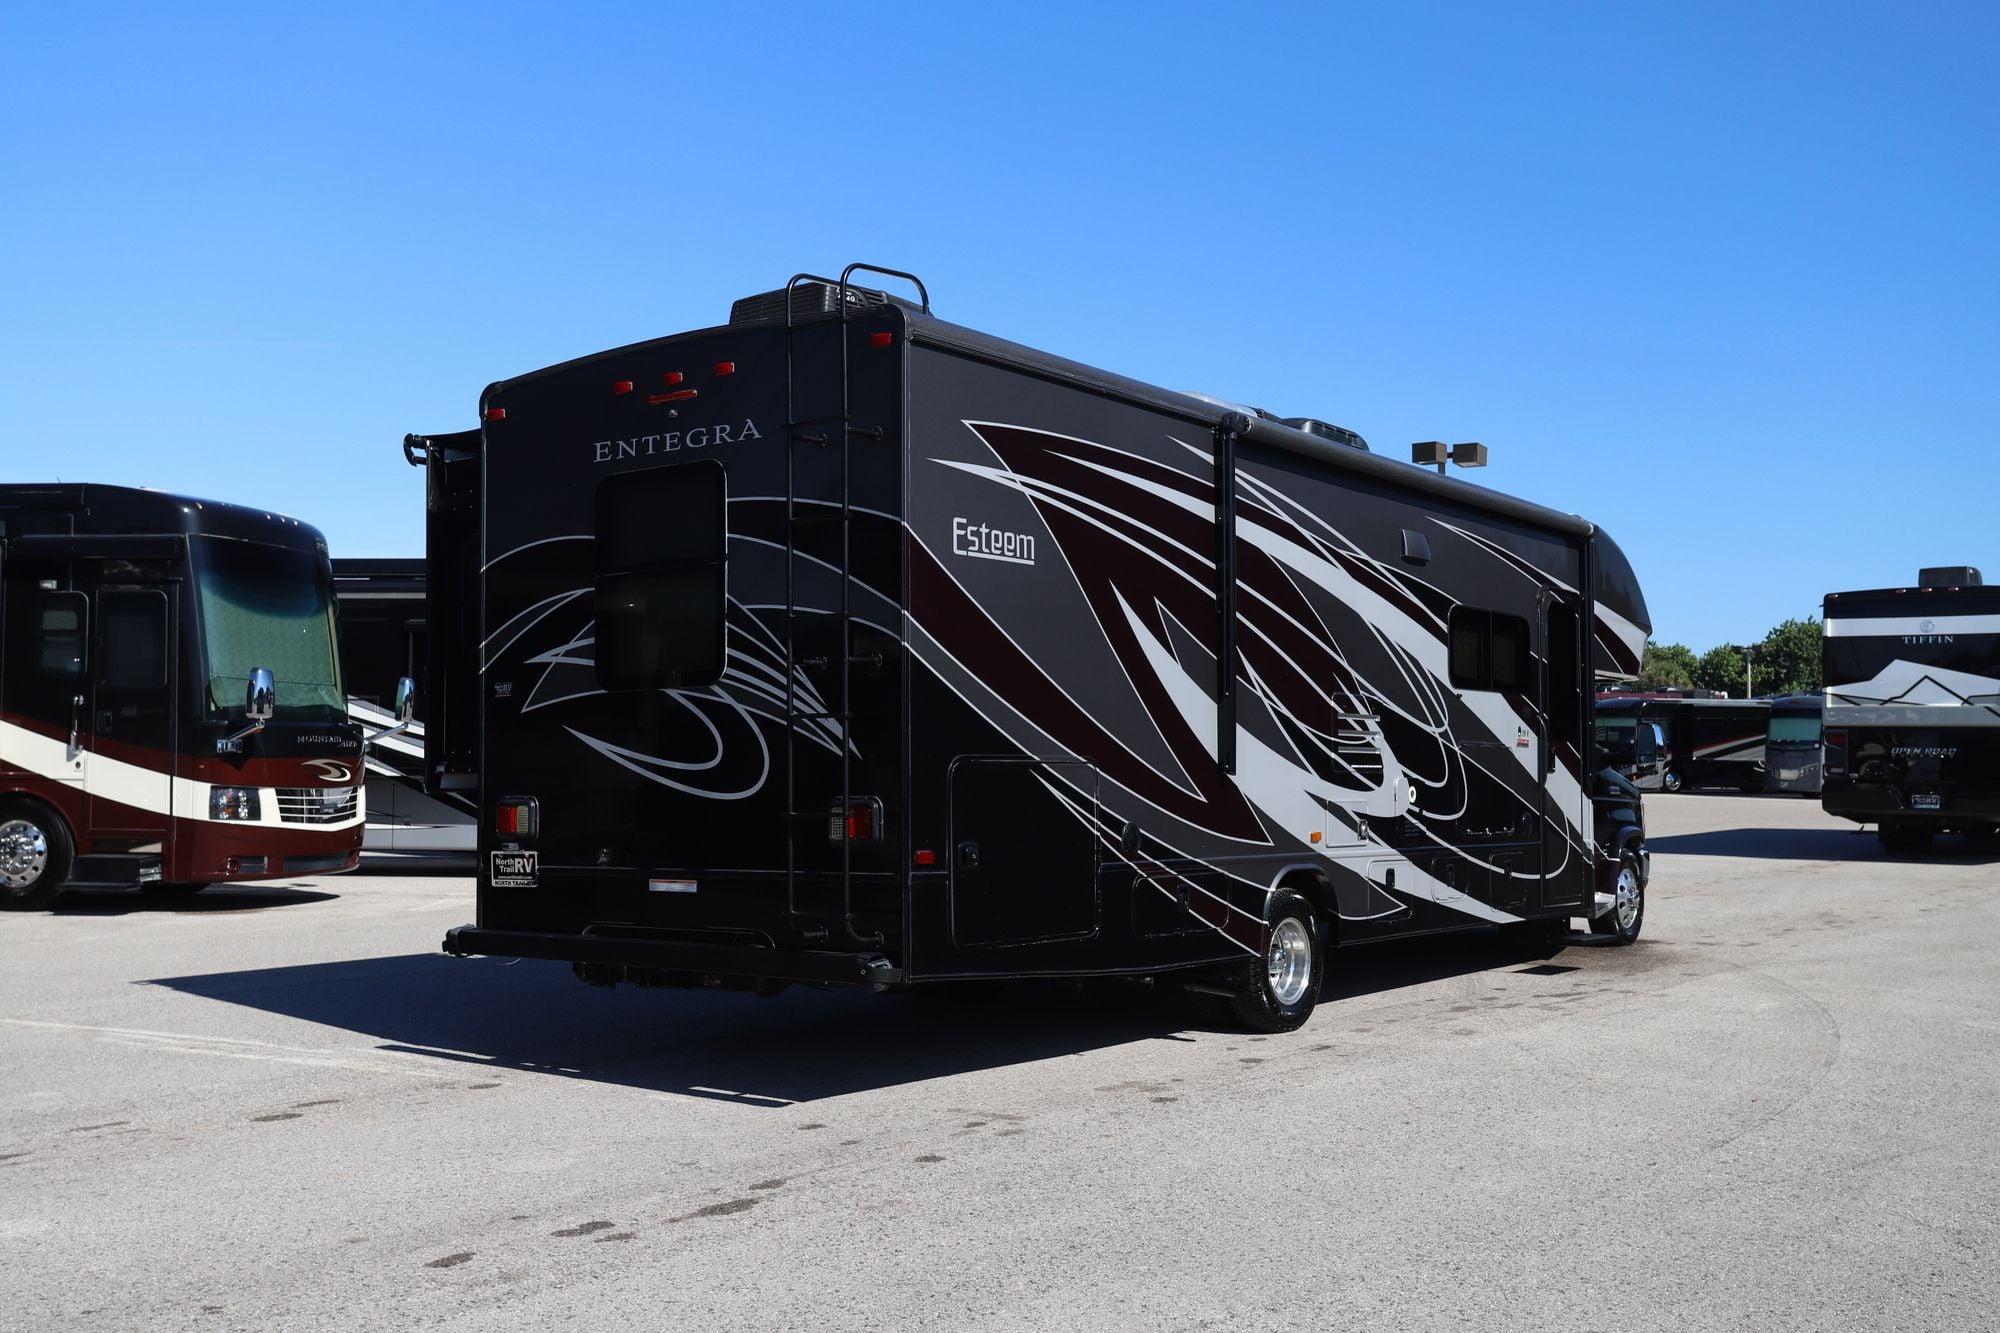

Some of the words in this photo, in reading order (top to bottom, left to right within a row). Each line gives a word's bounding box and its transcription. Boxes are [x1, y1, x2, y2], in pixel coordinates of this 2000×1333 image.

[593, 418, 763, 462] ENTEGRA
[953, 516, 1035, 562] Esteem
[1902, 635, 1954, 644] TIFFIN
[297, 735, 342, 743] MOUNTAIN
[1924, 747, 1957, 755] ROAD
[514, 858, 533, 873] RV
